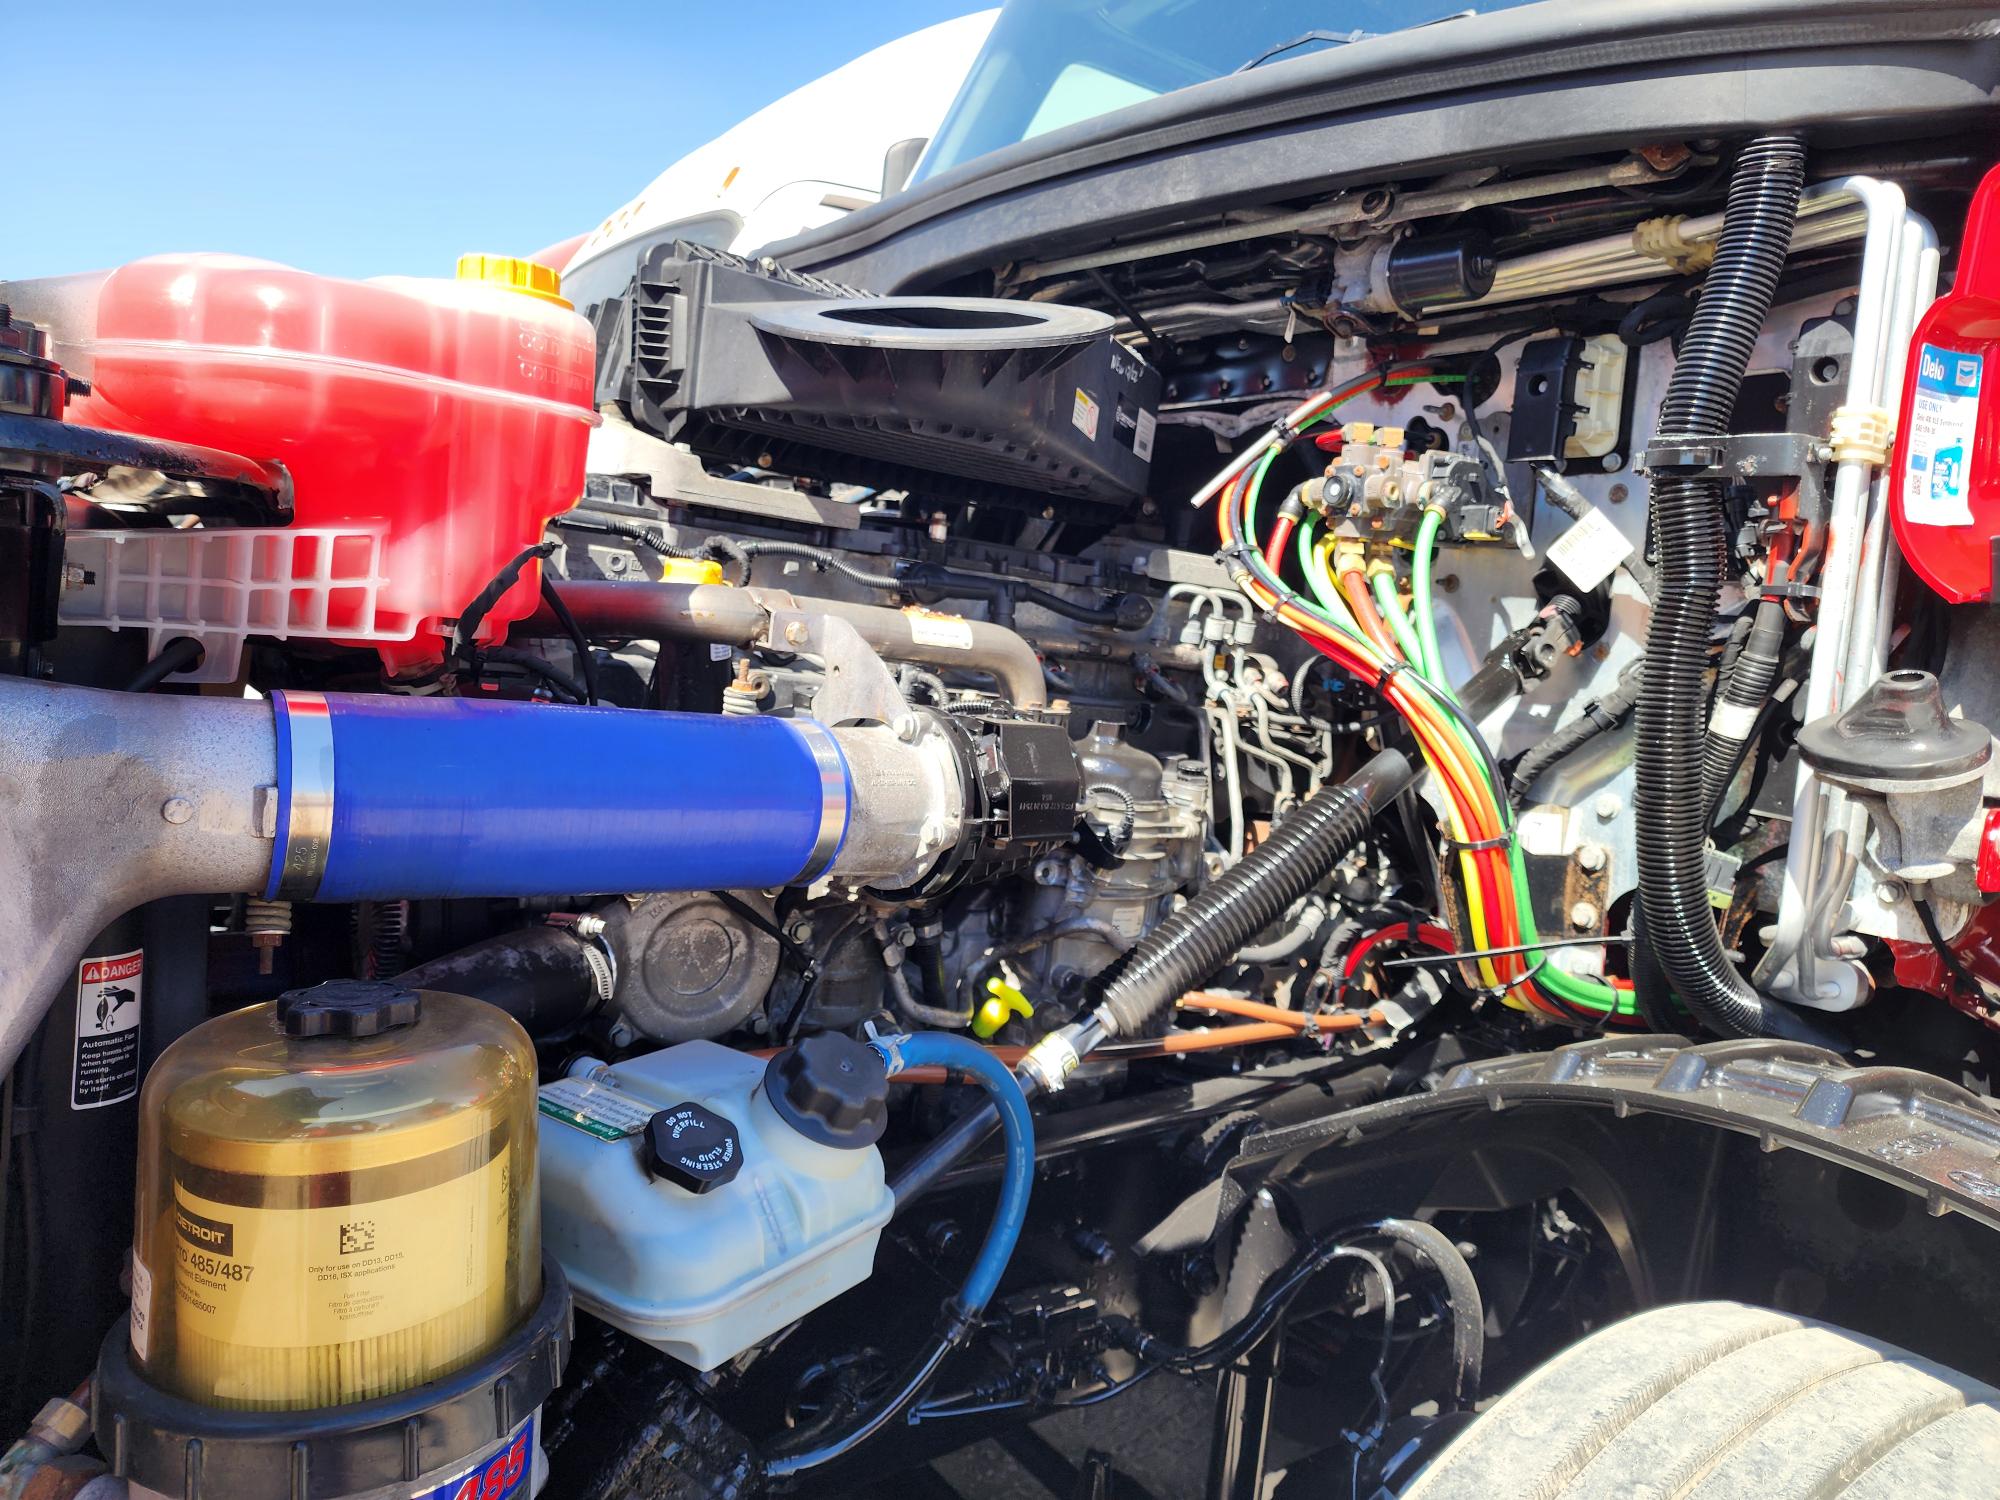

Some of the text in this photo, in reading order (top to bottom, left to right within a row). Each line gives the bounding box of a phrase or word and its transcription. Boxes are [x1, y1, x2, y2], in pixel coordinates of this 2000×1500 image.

[1922, 354, 1945, 381] Delo
[101, 960, 142, 979] DANGER
[82, 1037, 124, 1049] Automatic
[80, 1060, 101, 1068] when
[80, 1066, 111, 1076] running.
[95, 1075, 116, 1084] starts
[79, 1087, 89, 1095] by
[665, 1111, 693, 1127] DO NOT
[672, 1118, 706, 1139] OVERFILL
[680, 1138, 733, 1171] POWER STEERING
[698, 1146, 723, 1162] FLUID
[190, 1252, 255, 1283] 485/487
[317, 1264, 396, 1281] DD16, ISX applications
[325, 1264, 336, 1272] for
[362, 1257, 383, 1267] DD13,
[195, 1273, 227, 1292] Element
